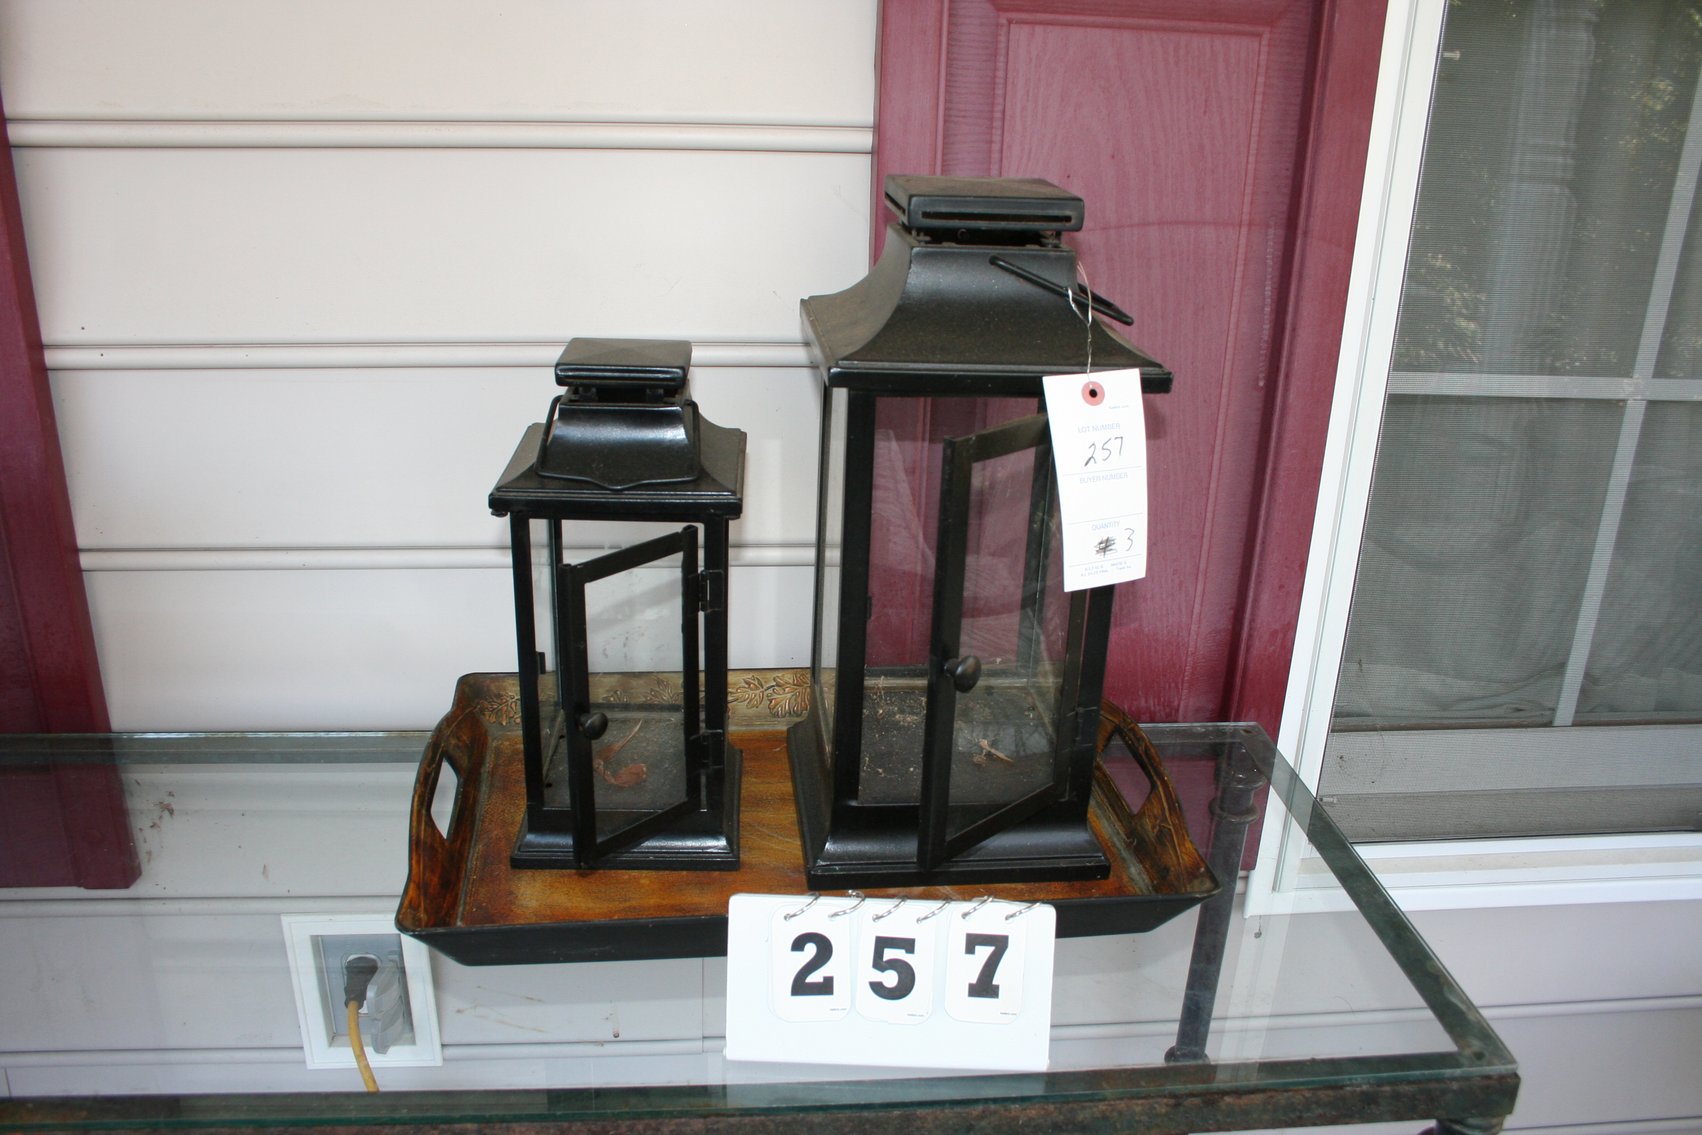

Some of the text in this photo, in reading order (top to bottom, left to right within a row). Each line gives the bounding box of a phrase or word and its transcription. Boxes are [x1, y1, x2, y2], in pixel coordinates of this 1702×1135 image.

[1077, 422, 1121, 434] LOT NUMBER
[1084, 435, 1124, 467] 257
[1079, 471, 1129, 485] BUYER NUMBER
[1091, 520, 1120, 531] QUANTITY
[1124, 527, 1135, 552] 3
